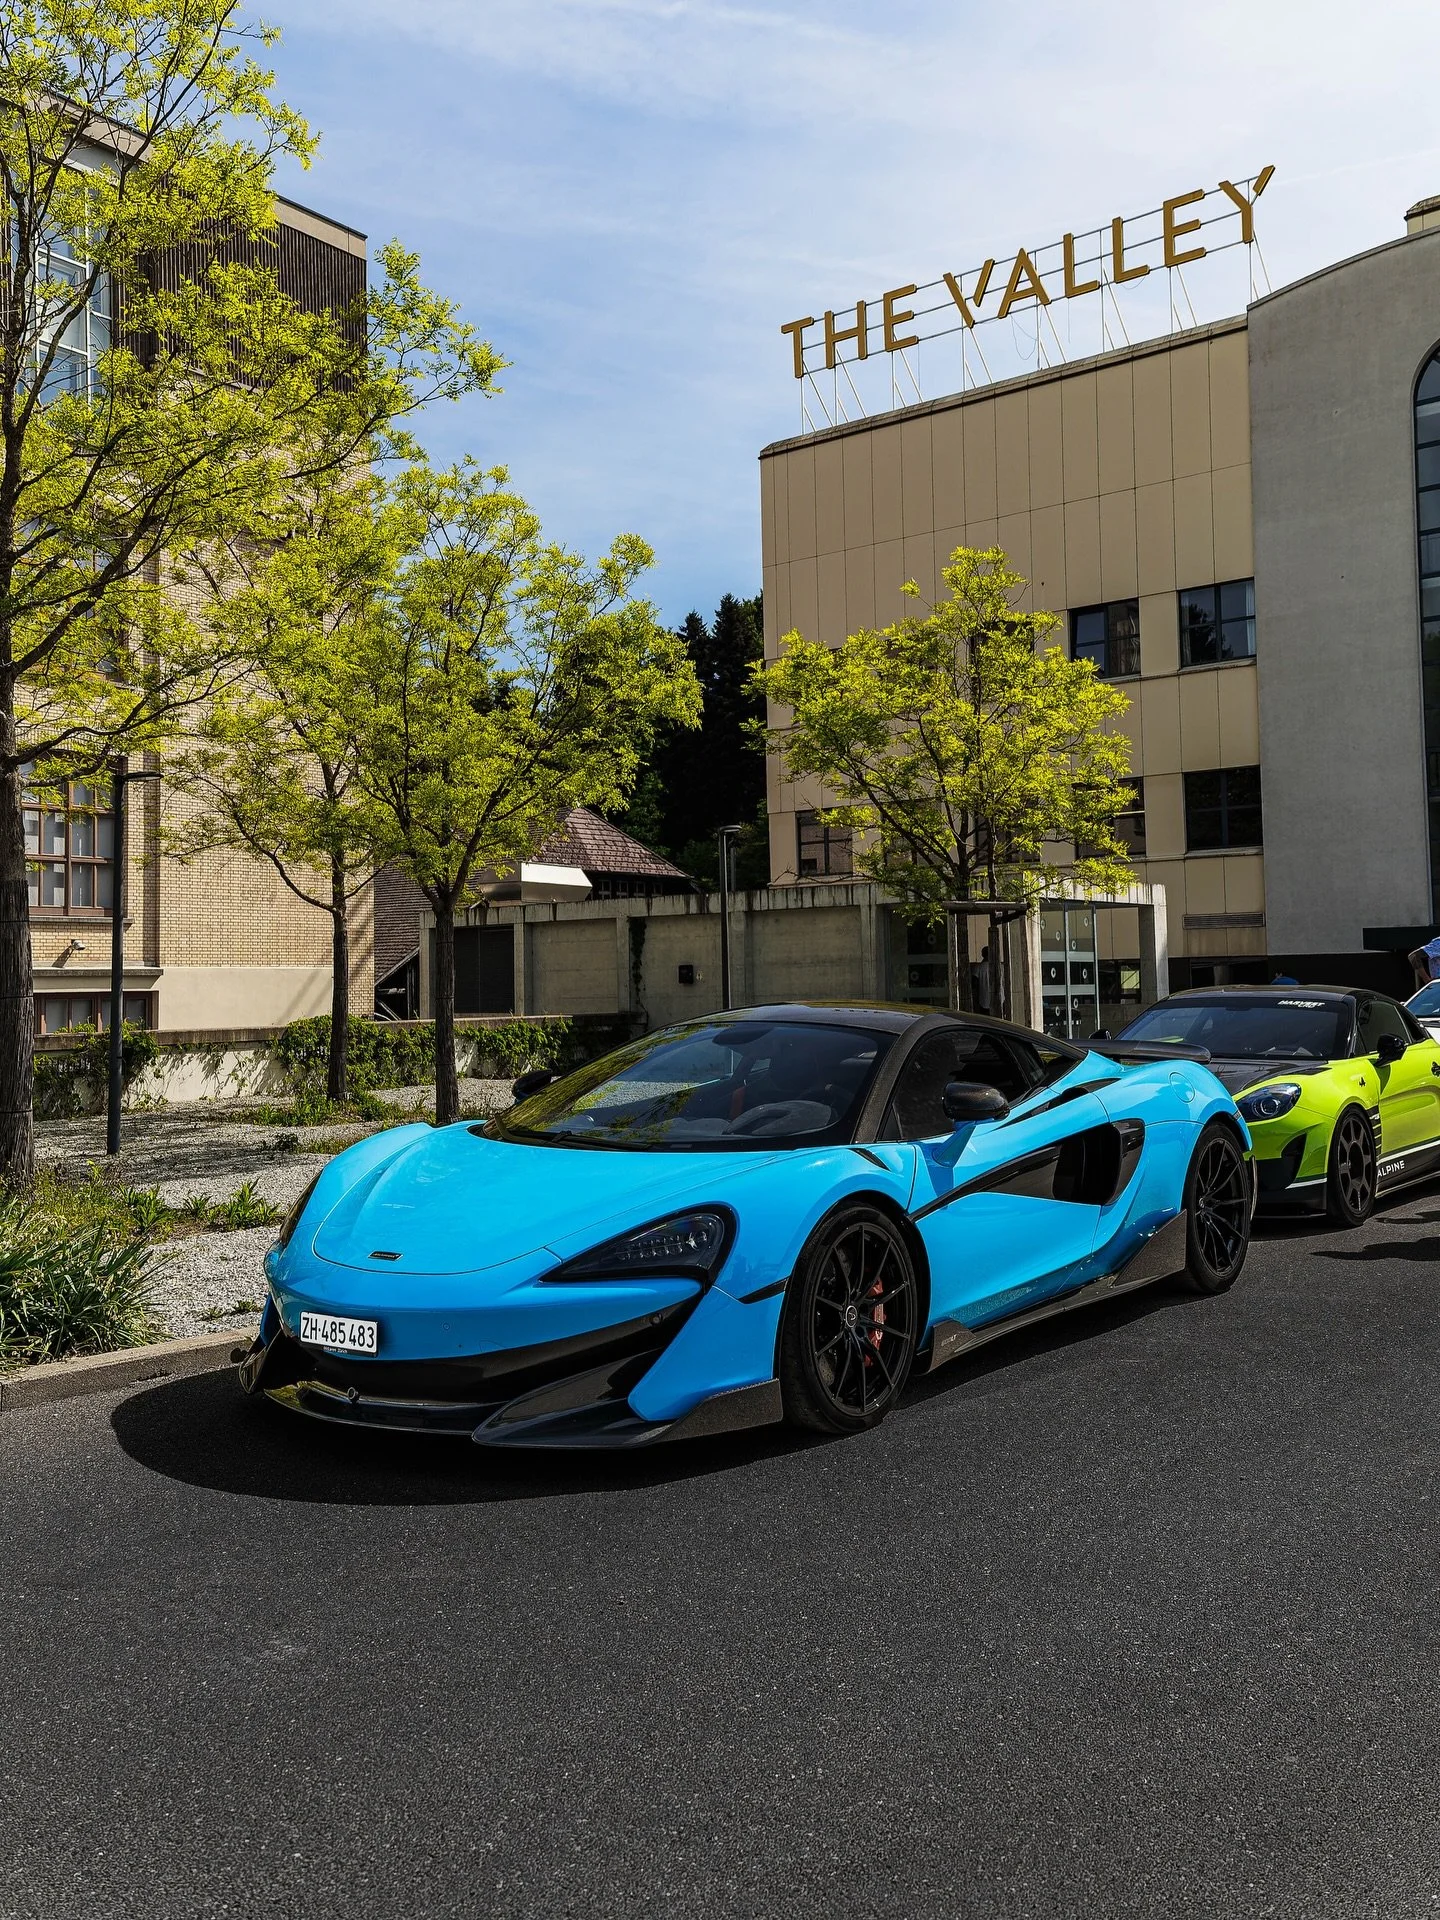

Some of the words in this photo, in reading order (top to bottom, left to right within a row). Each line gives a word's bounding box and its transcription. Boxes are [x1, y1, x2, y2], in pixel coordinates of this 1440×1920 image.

[781, 284, 918, 378] THE
[943, 165, 1275, 328] VALLEY
[1377, 1160, 1405, 1177] ALPINE
